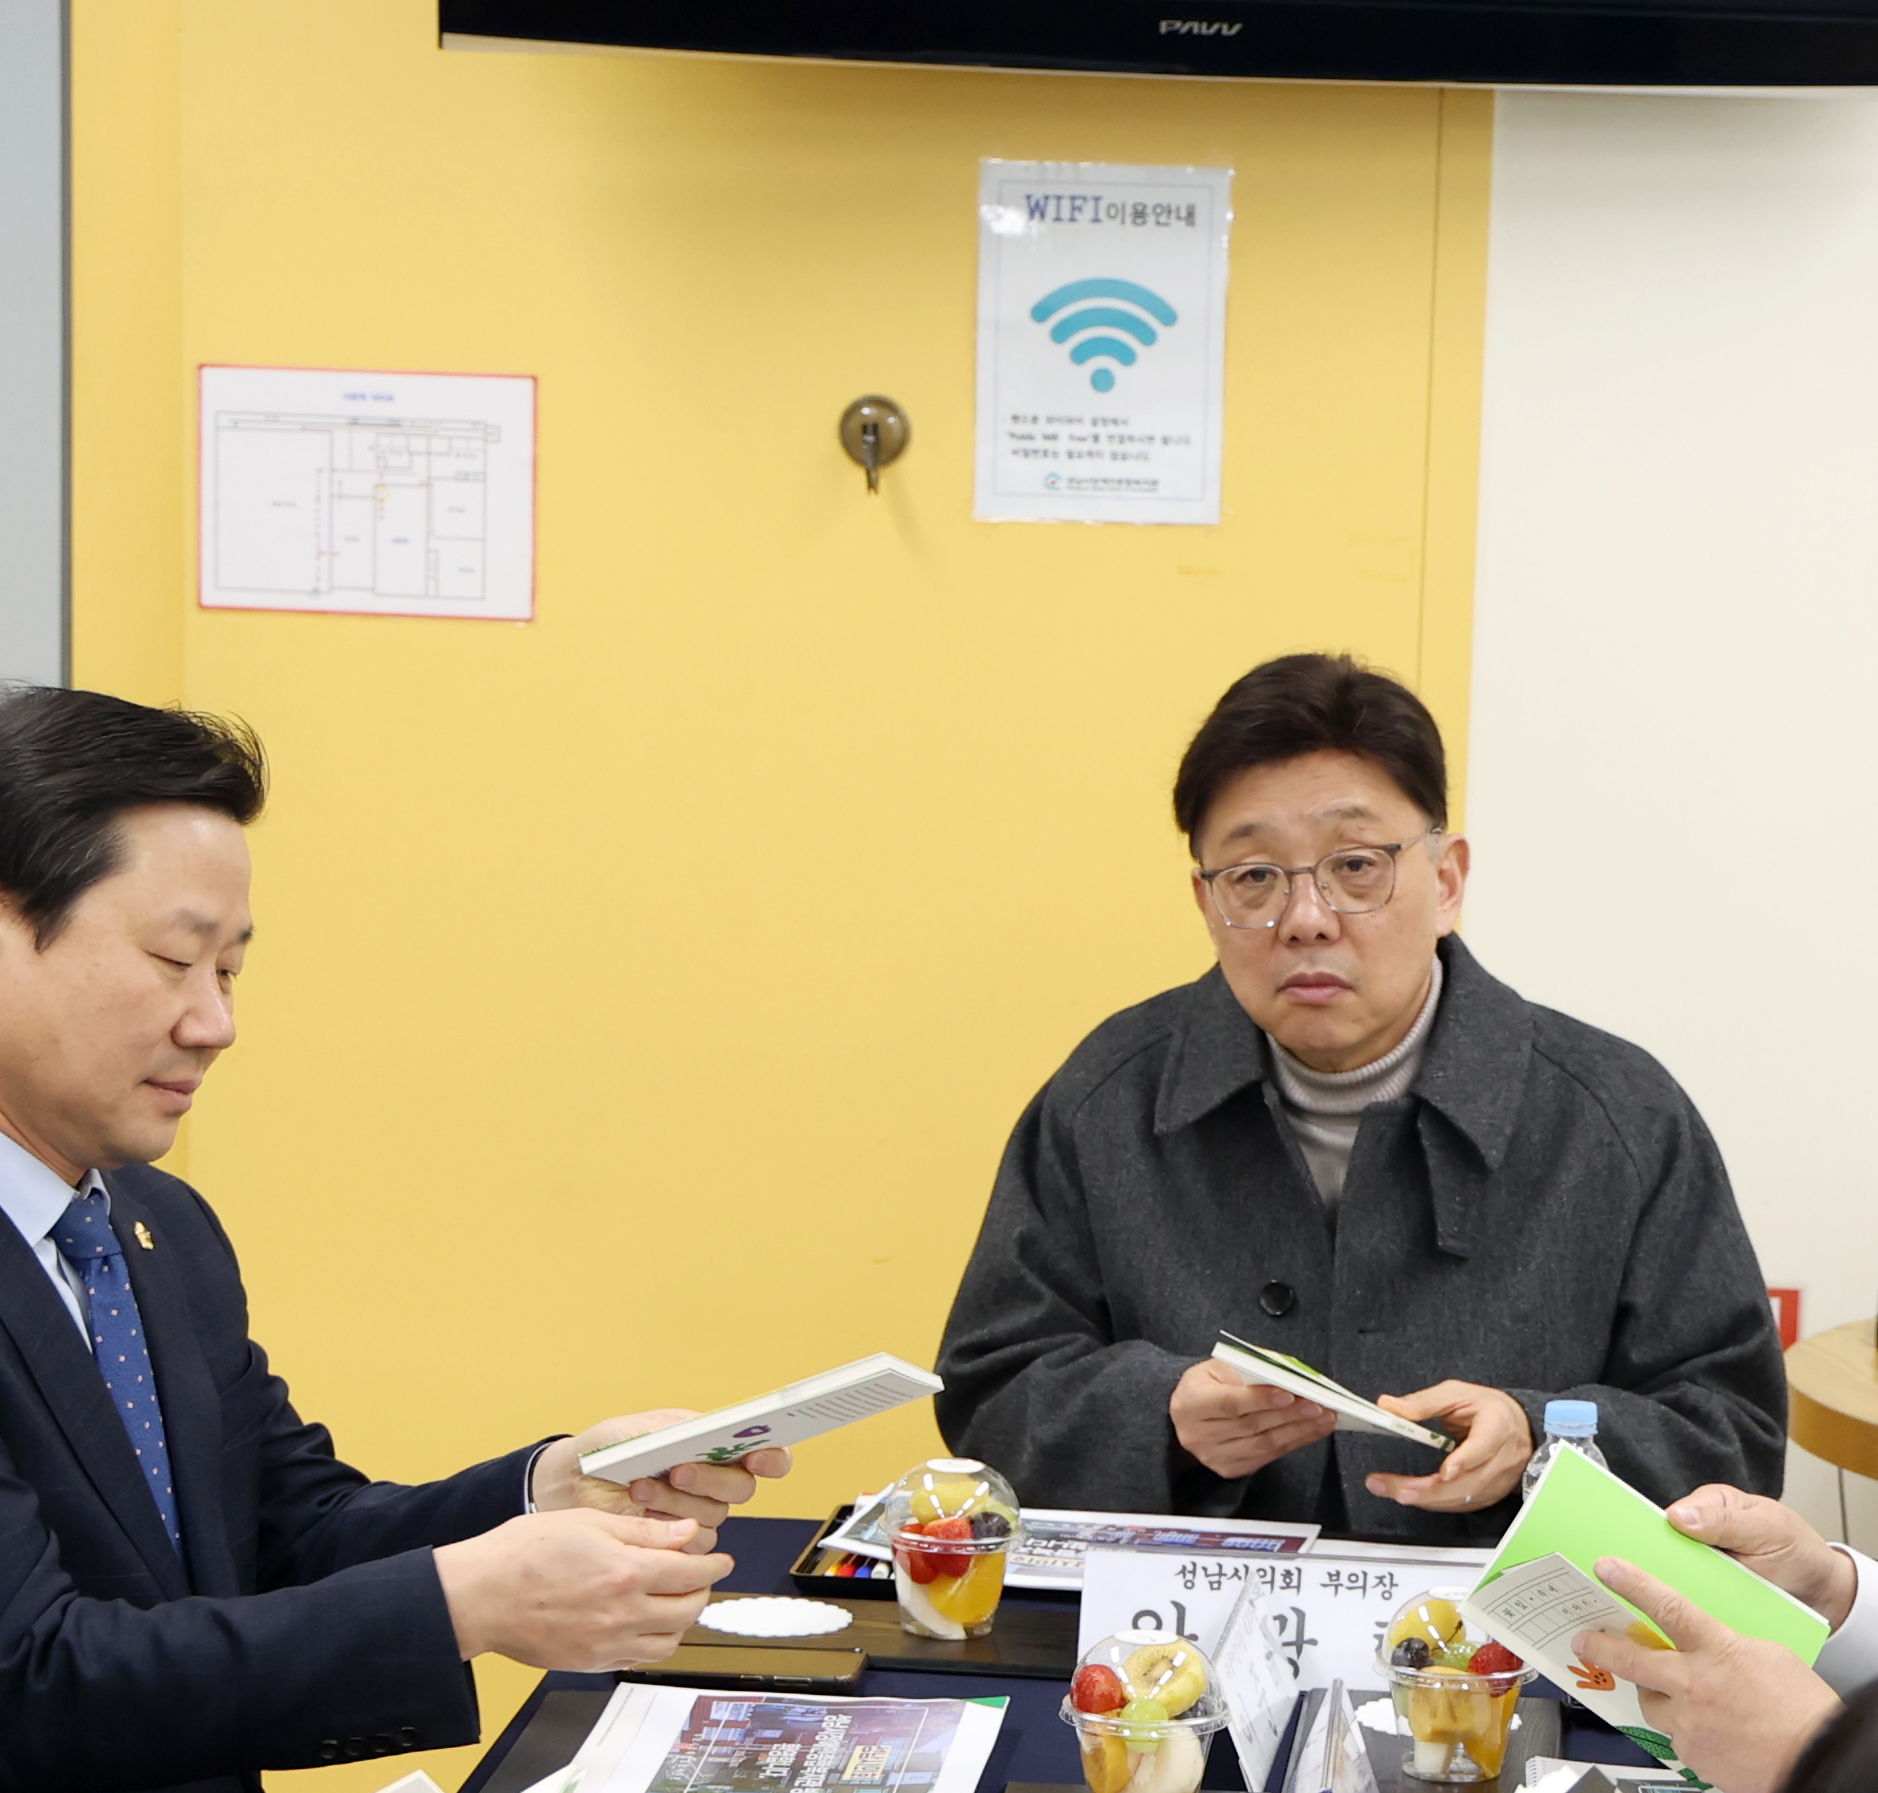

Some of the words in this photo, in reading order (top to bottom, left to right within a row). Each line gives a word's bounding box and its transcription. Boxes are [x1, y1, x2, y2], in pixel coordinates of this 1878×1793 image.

[1158, 19, 1243, 36] PAVV
[1174, 1561, 1303, 1596] 성남시의회
[1319, 1567, 1399, 1600] 부의장
[850, 1745, 889, 1780] 성남시의회
